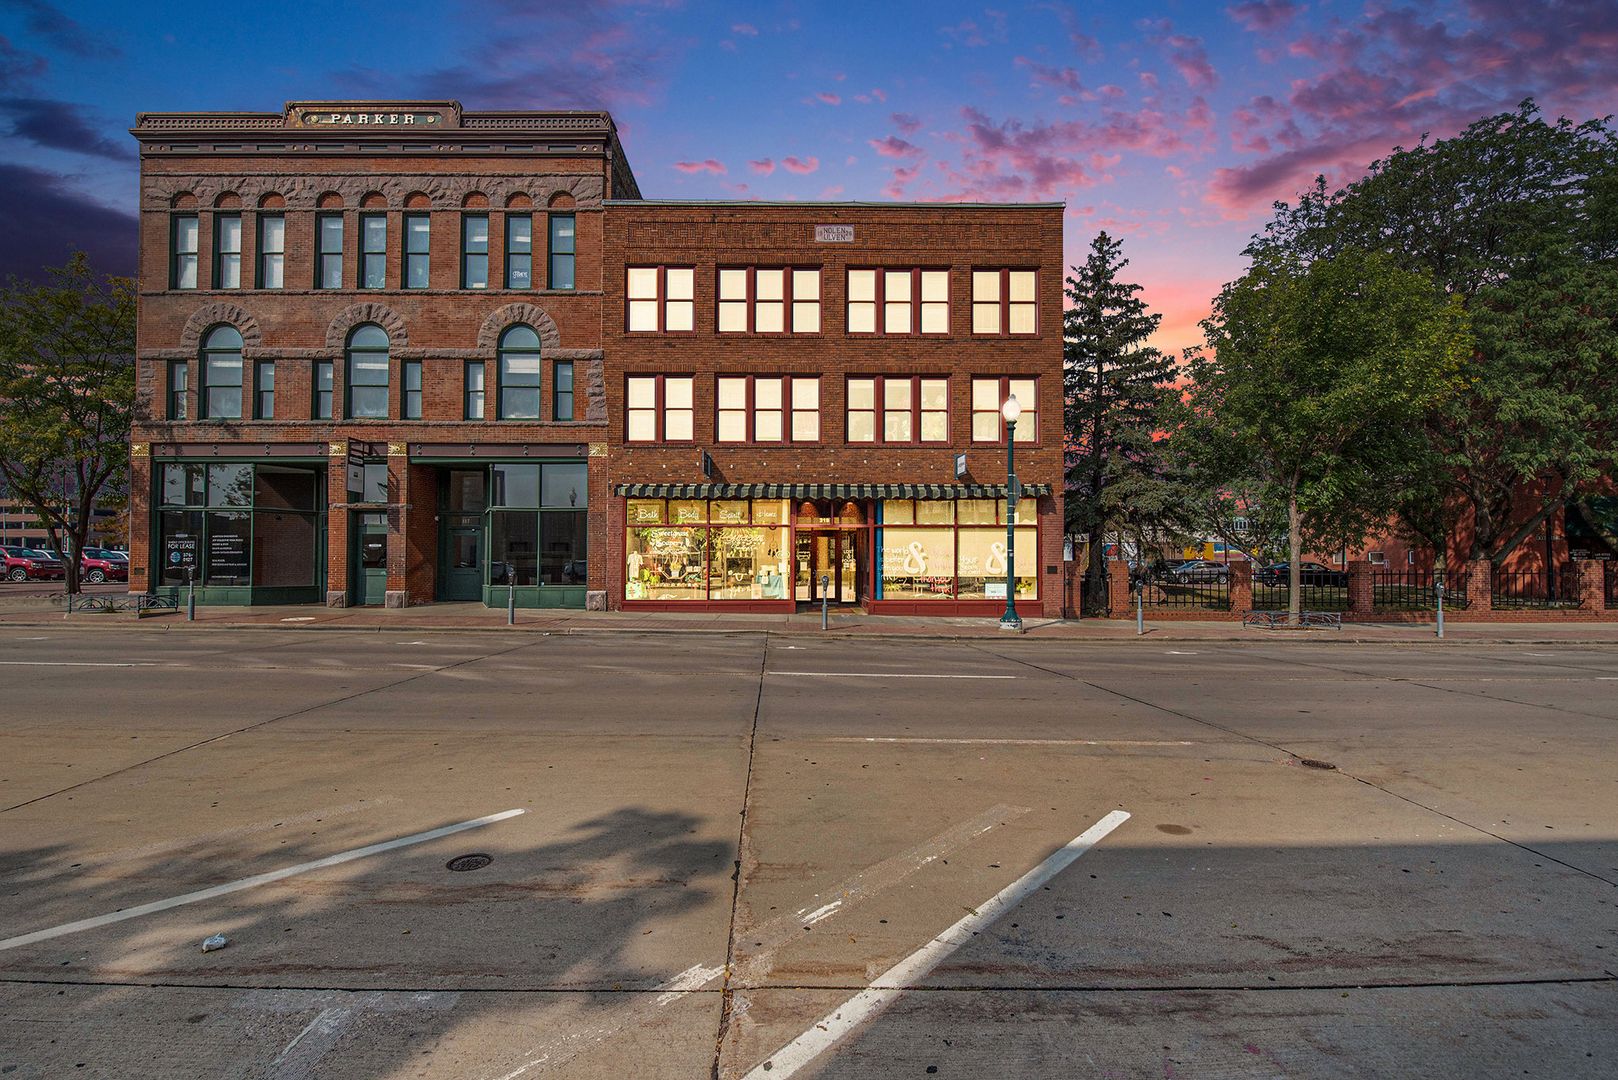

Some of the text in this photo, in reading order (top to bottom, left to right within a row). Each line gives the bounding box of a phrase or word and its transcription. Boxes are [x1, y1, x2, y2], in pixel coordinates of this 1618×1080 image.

[330, 113, 416, 125] PARKER
[639, 509, 659, 519] Bath
[678, 509, 699, 520] Body
